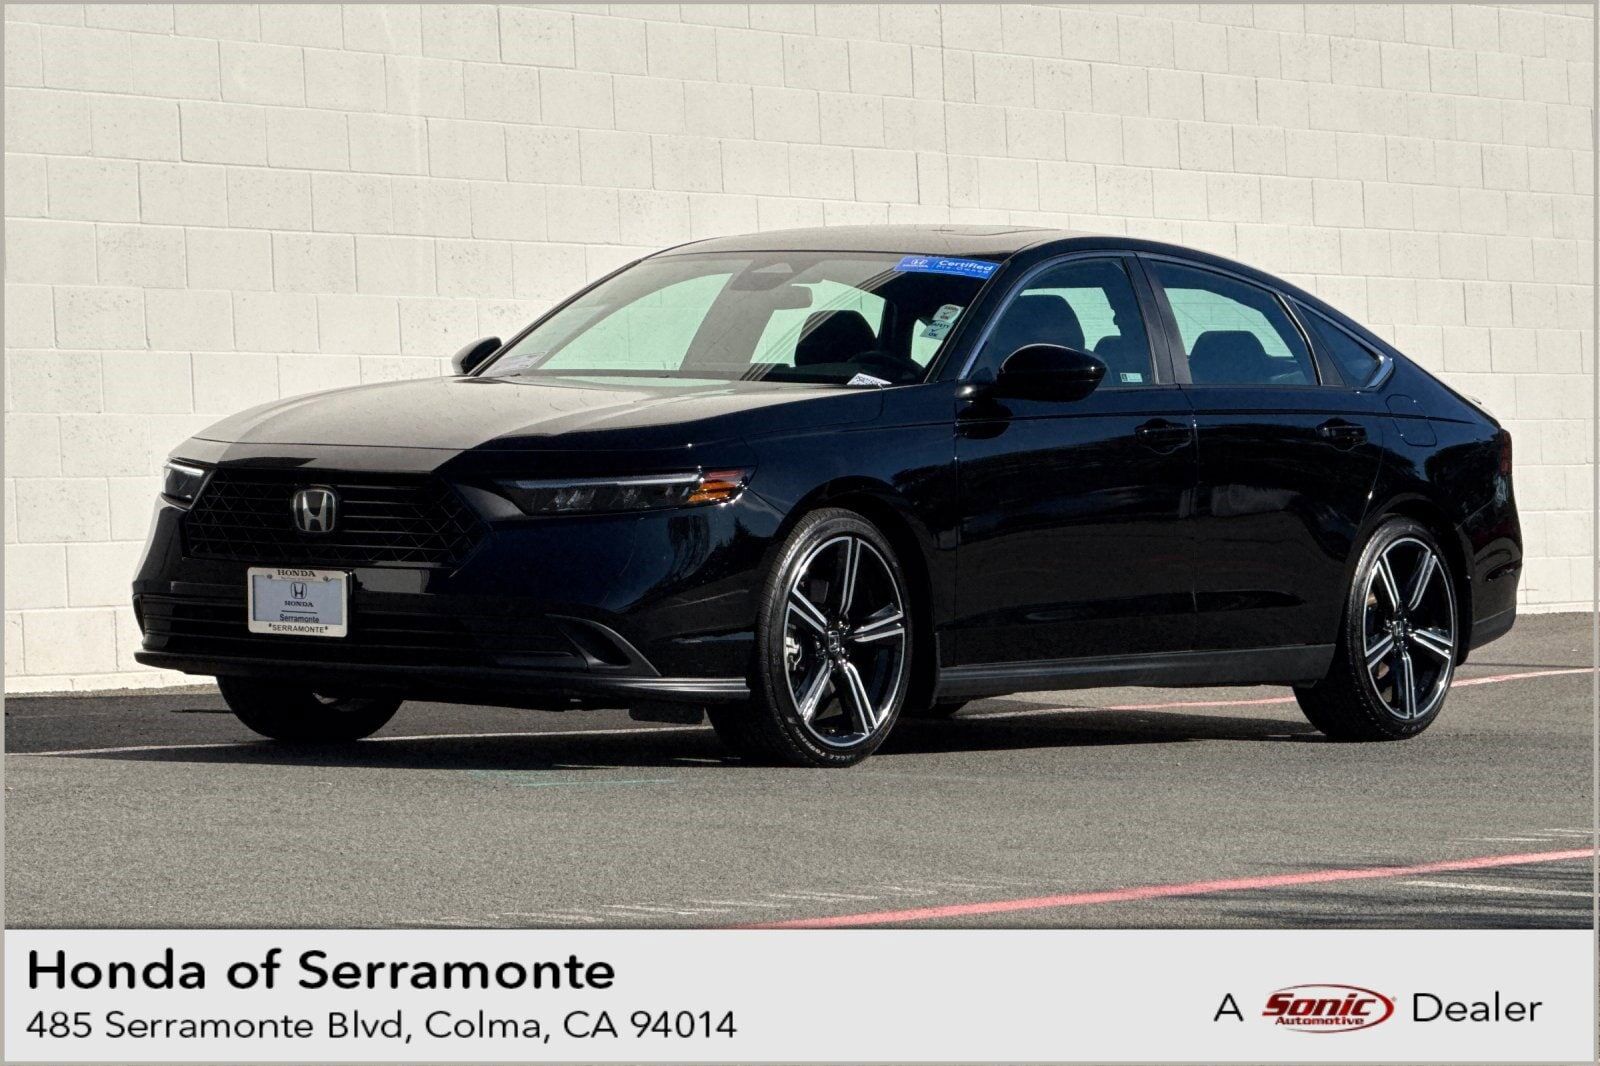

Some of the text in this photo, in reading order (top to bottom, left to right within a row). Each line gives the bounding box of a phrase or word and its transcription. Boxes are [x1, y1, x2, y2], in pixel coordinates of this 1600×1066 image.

[939, 260, 994, 271] Certified
[277, 569, 316, 577] HONDA
[284, 600, 314, 608] HONDA
[280, 613, 320, 624] Serramonte
